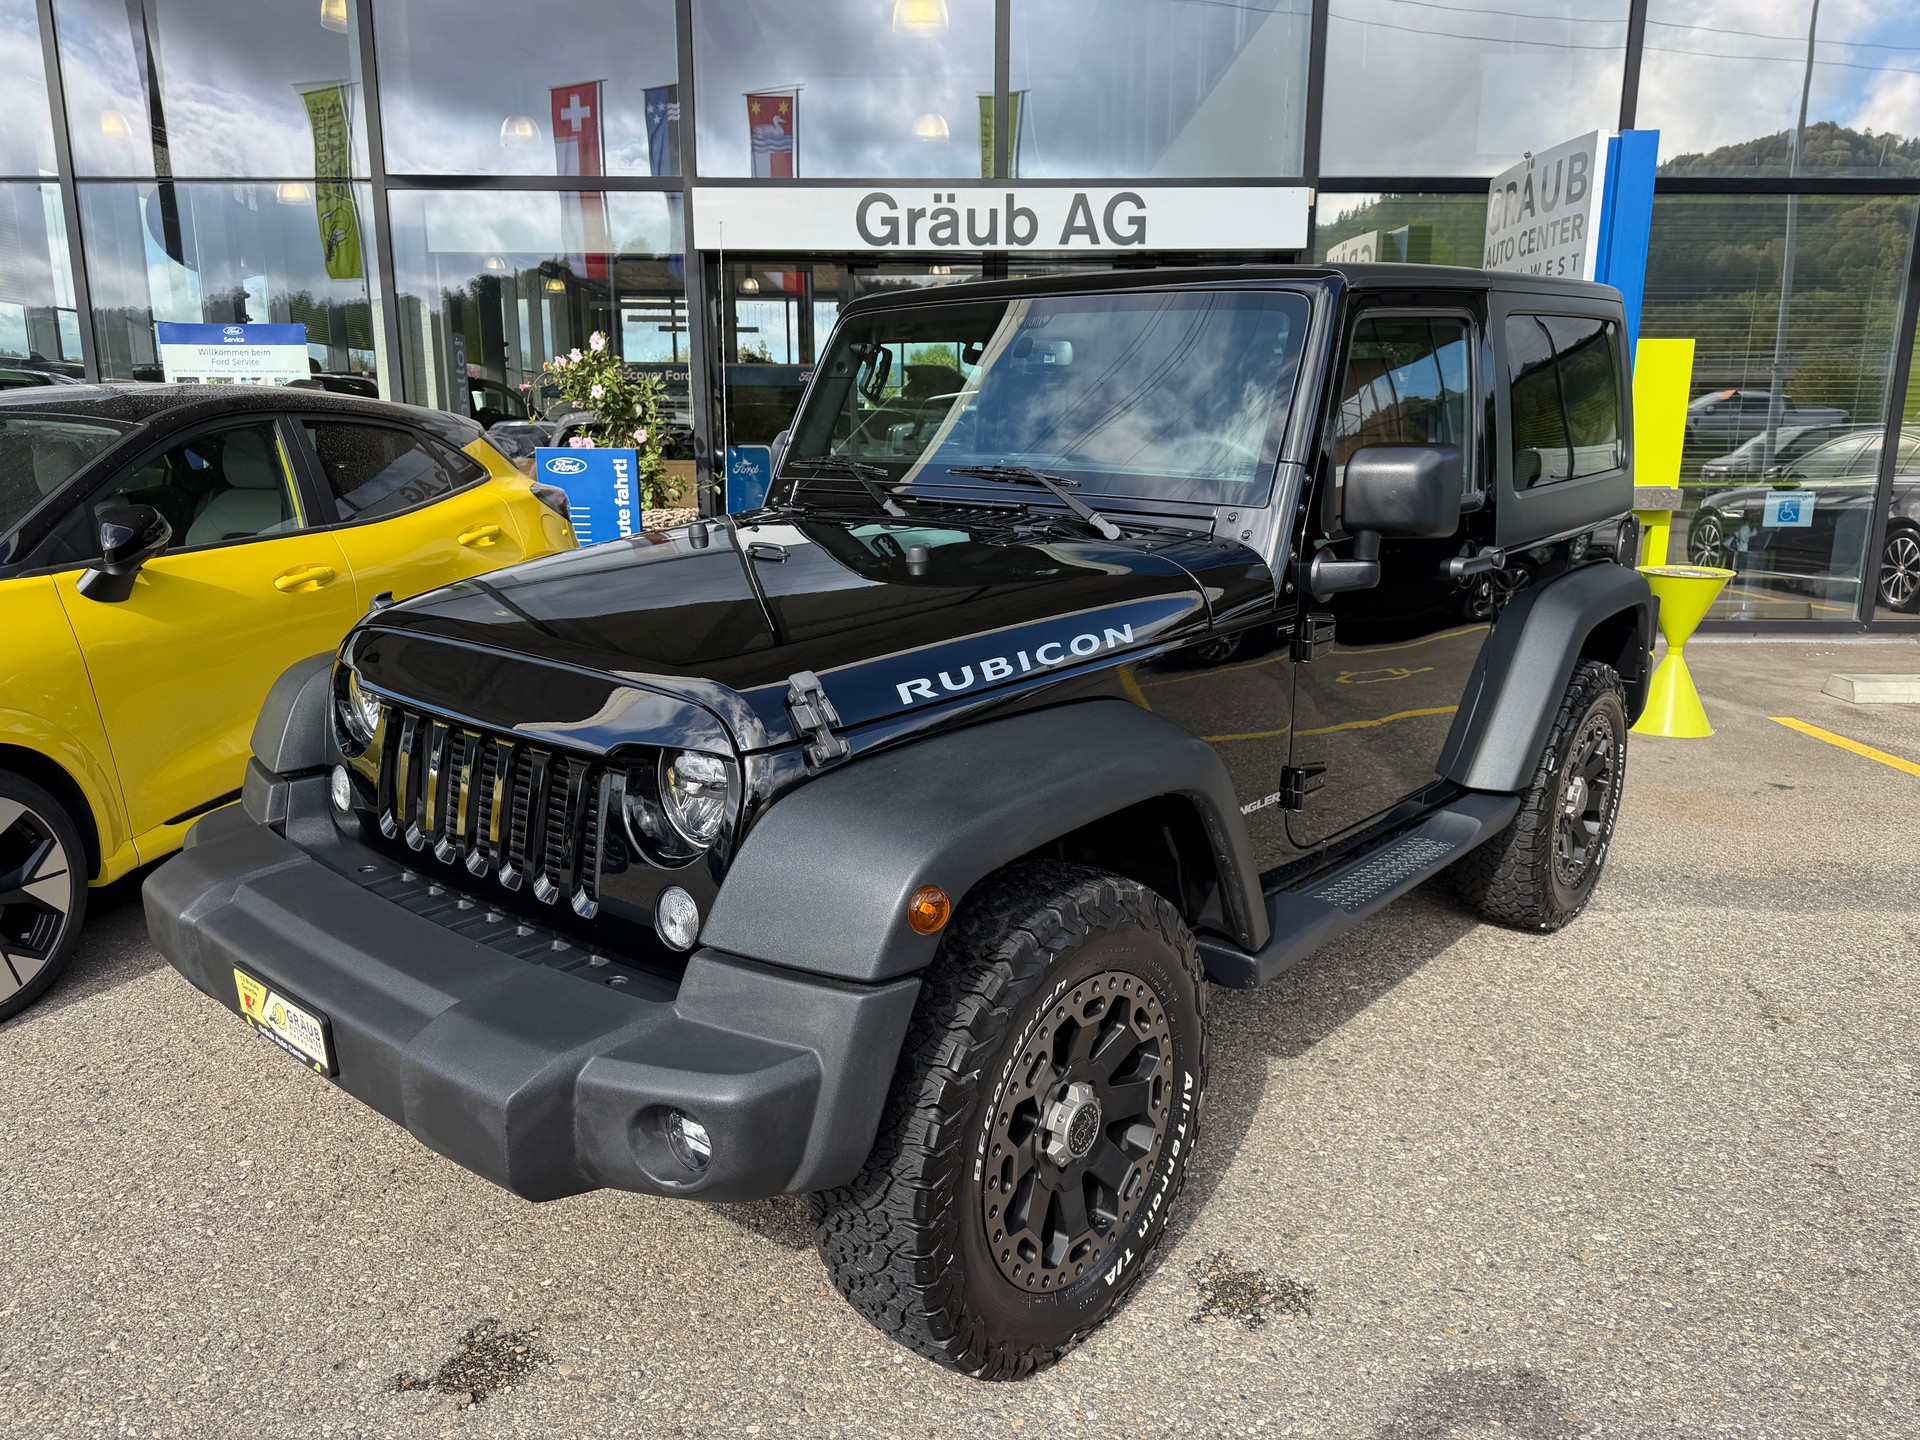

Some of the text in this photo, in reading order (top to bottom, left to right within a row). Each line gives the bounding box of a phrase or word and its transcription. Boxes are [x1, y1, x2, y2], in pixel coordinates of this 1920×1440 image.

[1489, 151, 1589, 235] GRÄUB
[855, 192, 1147, 247] Gräub AG
[1485, 212, 1584, 269] AUTO CENTER
[197, 348, 271, 356] Willkommen beim
[211, 358, 260, 366] Ford Service
[623, 371, 663, 380] scover
[552, 459, 582, 472] Ford
[613, 458, 630, 507] fahrt!
[732, 461, 760, 475] Ford
[895, 623, 1135, 705] RUBICON
[1239, 791, 1281, 815] NGLER
[286, 1009, 321, 1041] GRÄUB
[973, 978, 1068, 1182] BFGoodrich
[1137, 1070, 1195, 1239] All-Terrain
[1103, 1247, 1135, 1288] T/A
